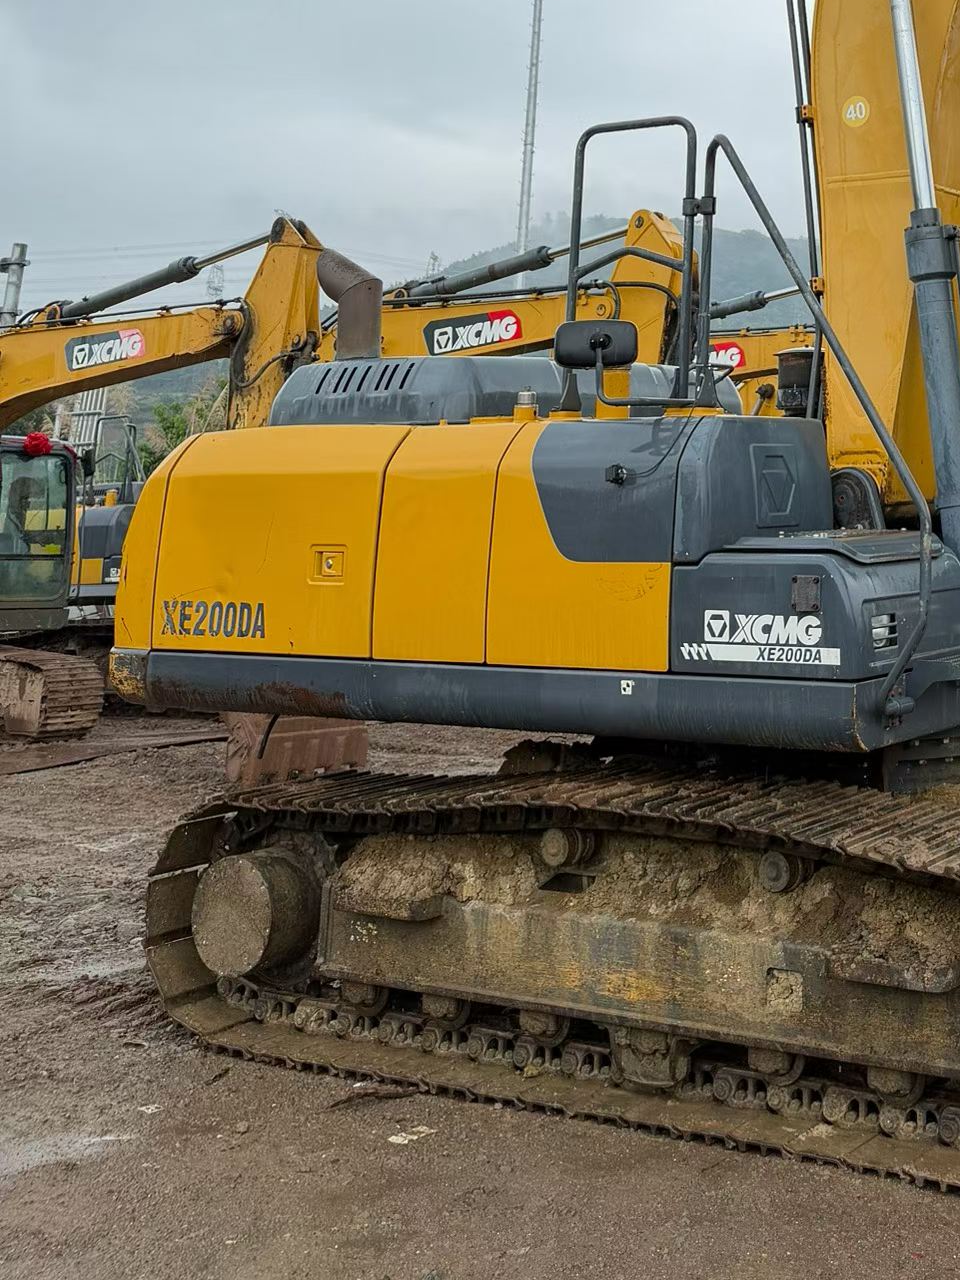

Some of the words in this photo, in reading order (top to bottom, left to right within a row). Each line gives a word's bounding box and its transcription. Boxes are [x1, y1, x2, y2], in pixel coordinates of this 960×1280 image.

[847, 101, 865, 120] 40
[452, 315, 517, 349] XCMG
[88, 334, 141, 365] XCMG
[708, 347, 741, 367] MG
[161, 600, 265, 638] XE200DA
[729, 614, 822, 646] XCMG
[757, 647, 822, 663] XE200DA
